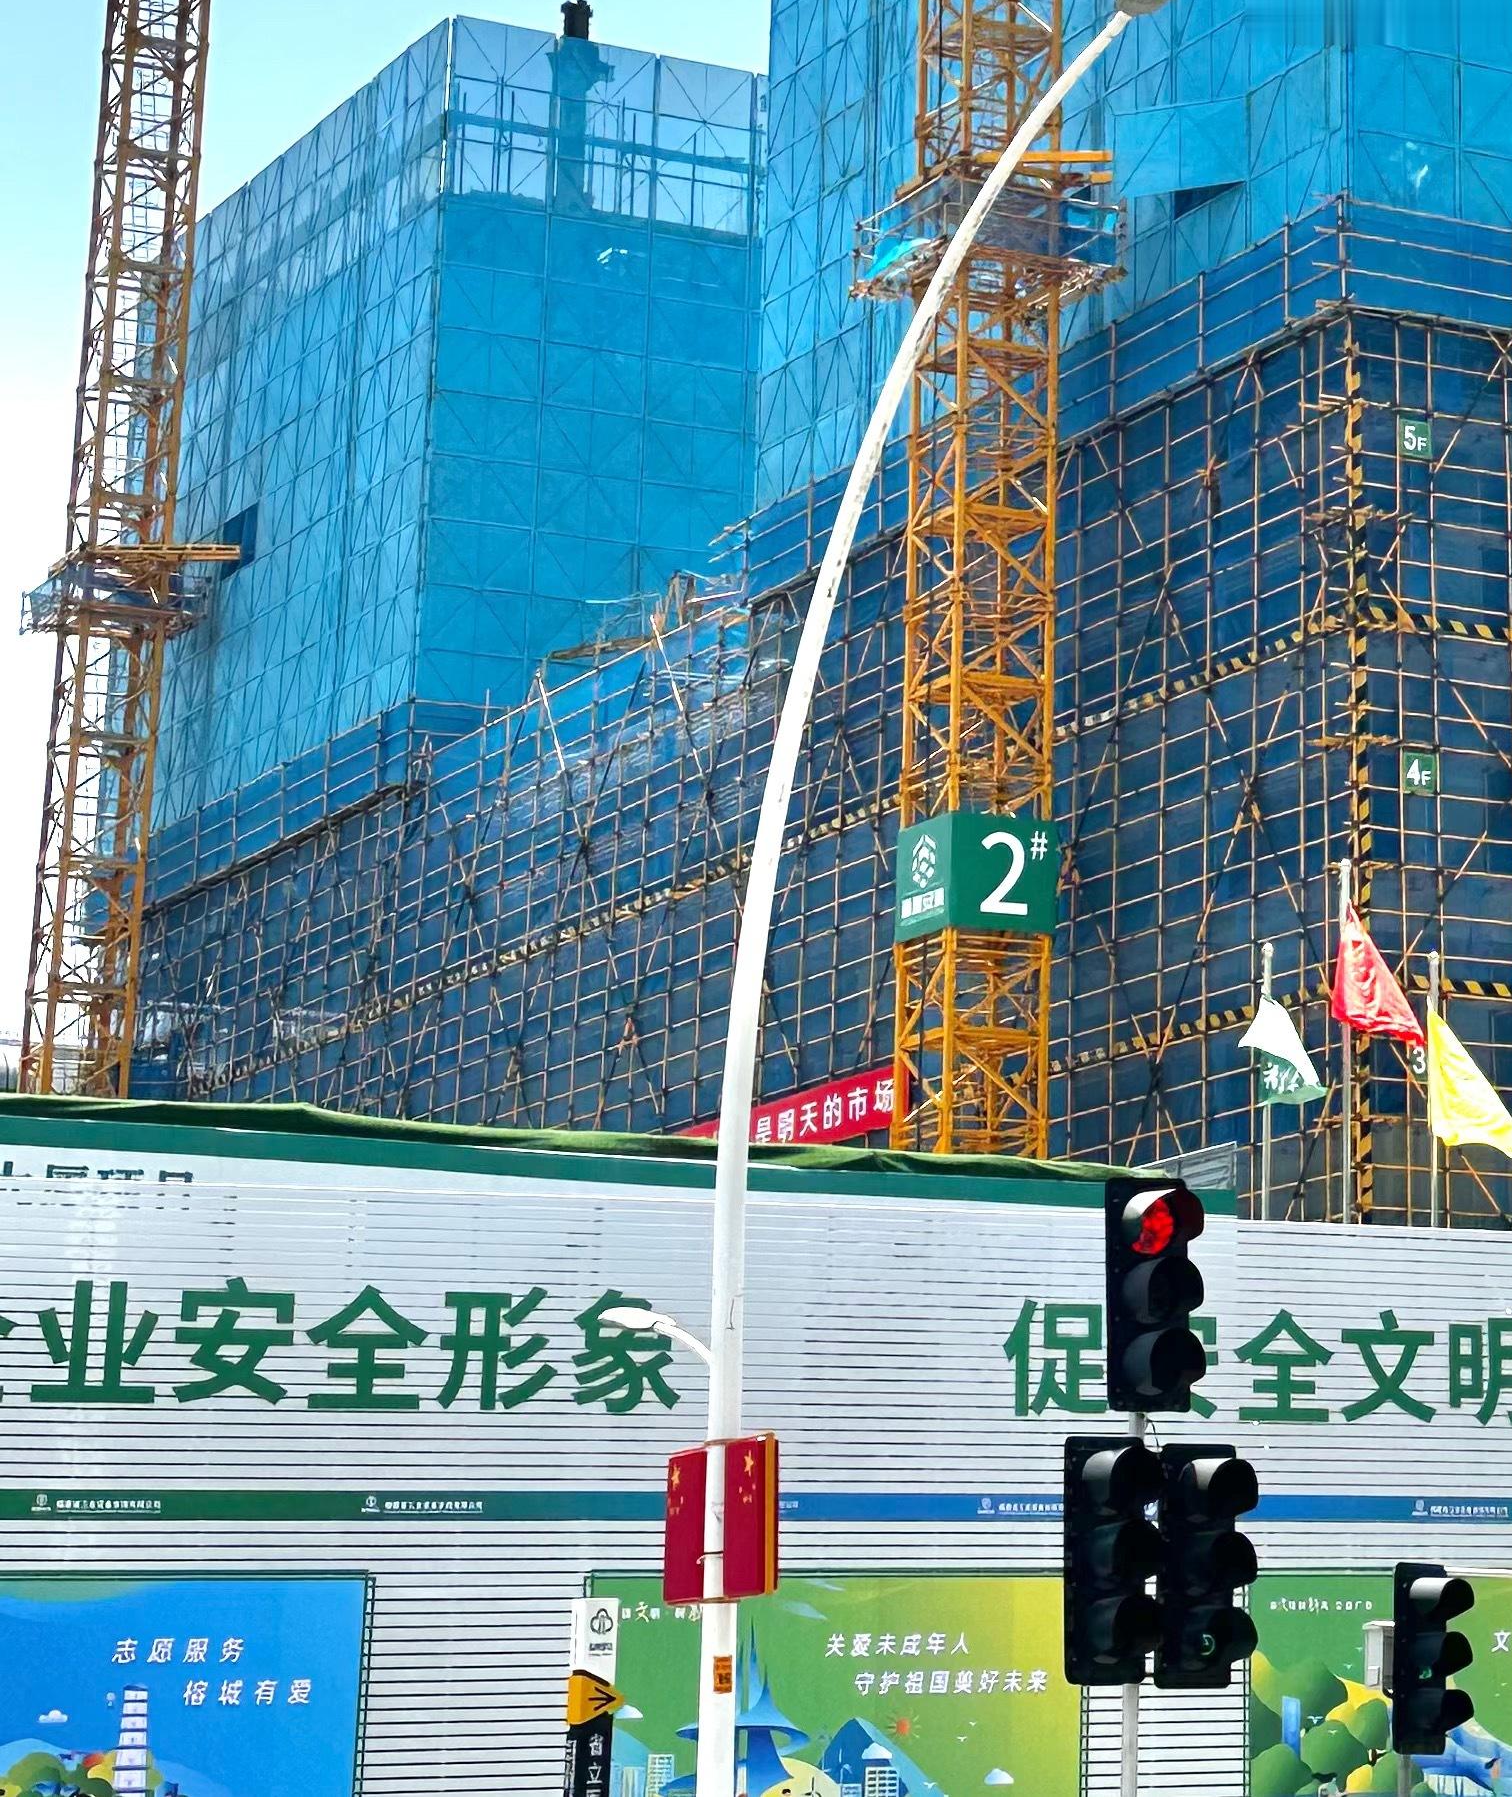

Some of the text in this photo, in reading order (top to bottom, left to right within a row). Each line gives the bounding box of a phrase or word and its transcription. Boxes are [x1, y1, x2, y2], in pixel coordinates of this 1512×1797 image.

[1403, 425, 1428, 451] 5F
[1406, 758, 1431, 786] 4F
[0, 1276, 681, 1413] 业安全形象
[111, 1638, 244, 1664] 志愿服务
[825, 1632, 969, 1657] 关爱未成年人
[183, 1679, 311, 1706] 榕城有爱
[854, 1669, 1047, 1696] 守护祖国美好未来
